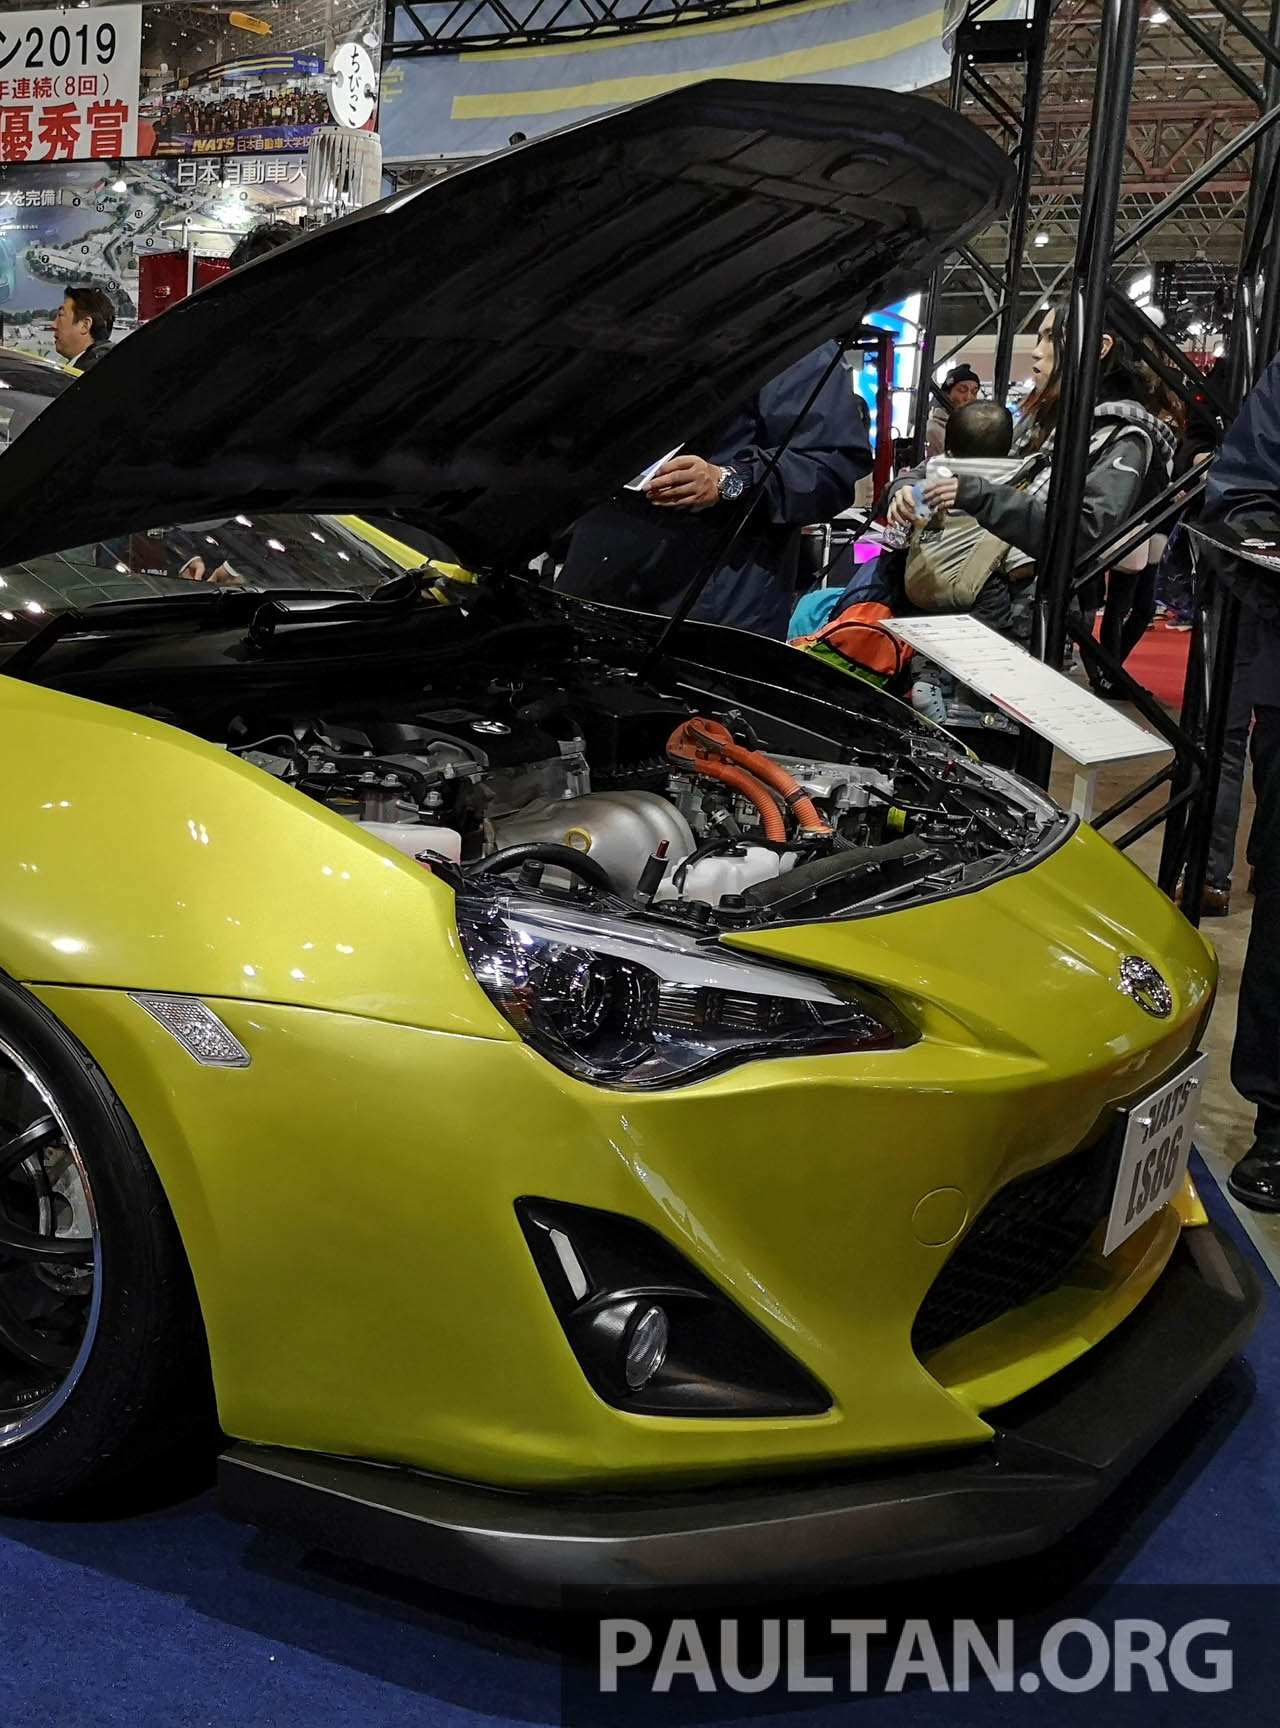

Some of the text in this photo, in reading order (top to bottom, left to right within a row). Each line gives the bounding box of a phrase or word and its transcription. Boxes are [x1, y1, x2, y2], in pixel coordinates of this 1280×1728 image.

[347, 46, 363, 128] ちびっこ
[177, 159, 307, 187] 日本自動車大
[192, 138, 235, 152] NATS
[1142, 1078, 1196, 1144] NATS
[1123, 1124, 1184, 1226] LS86
